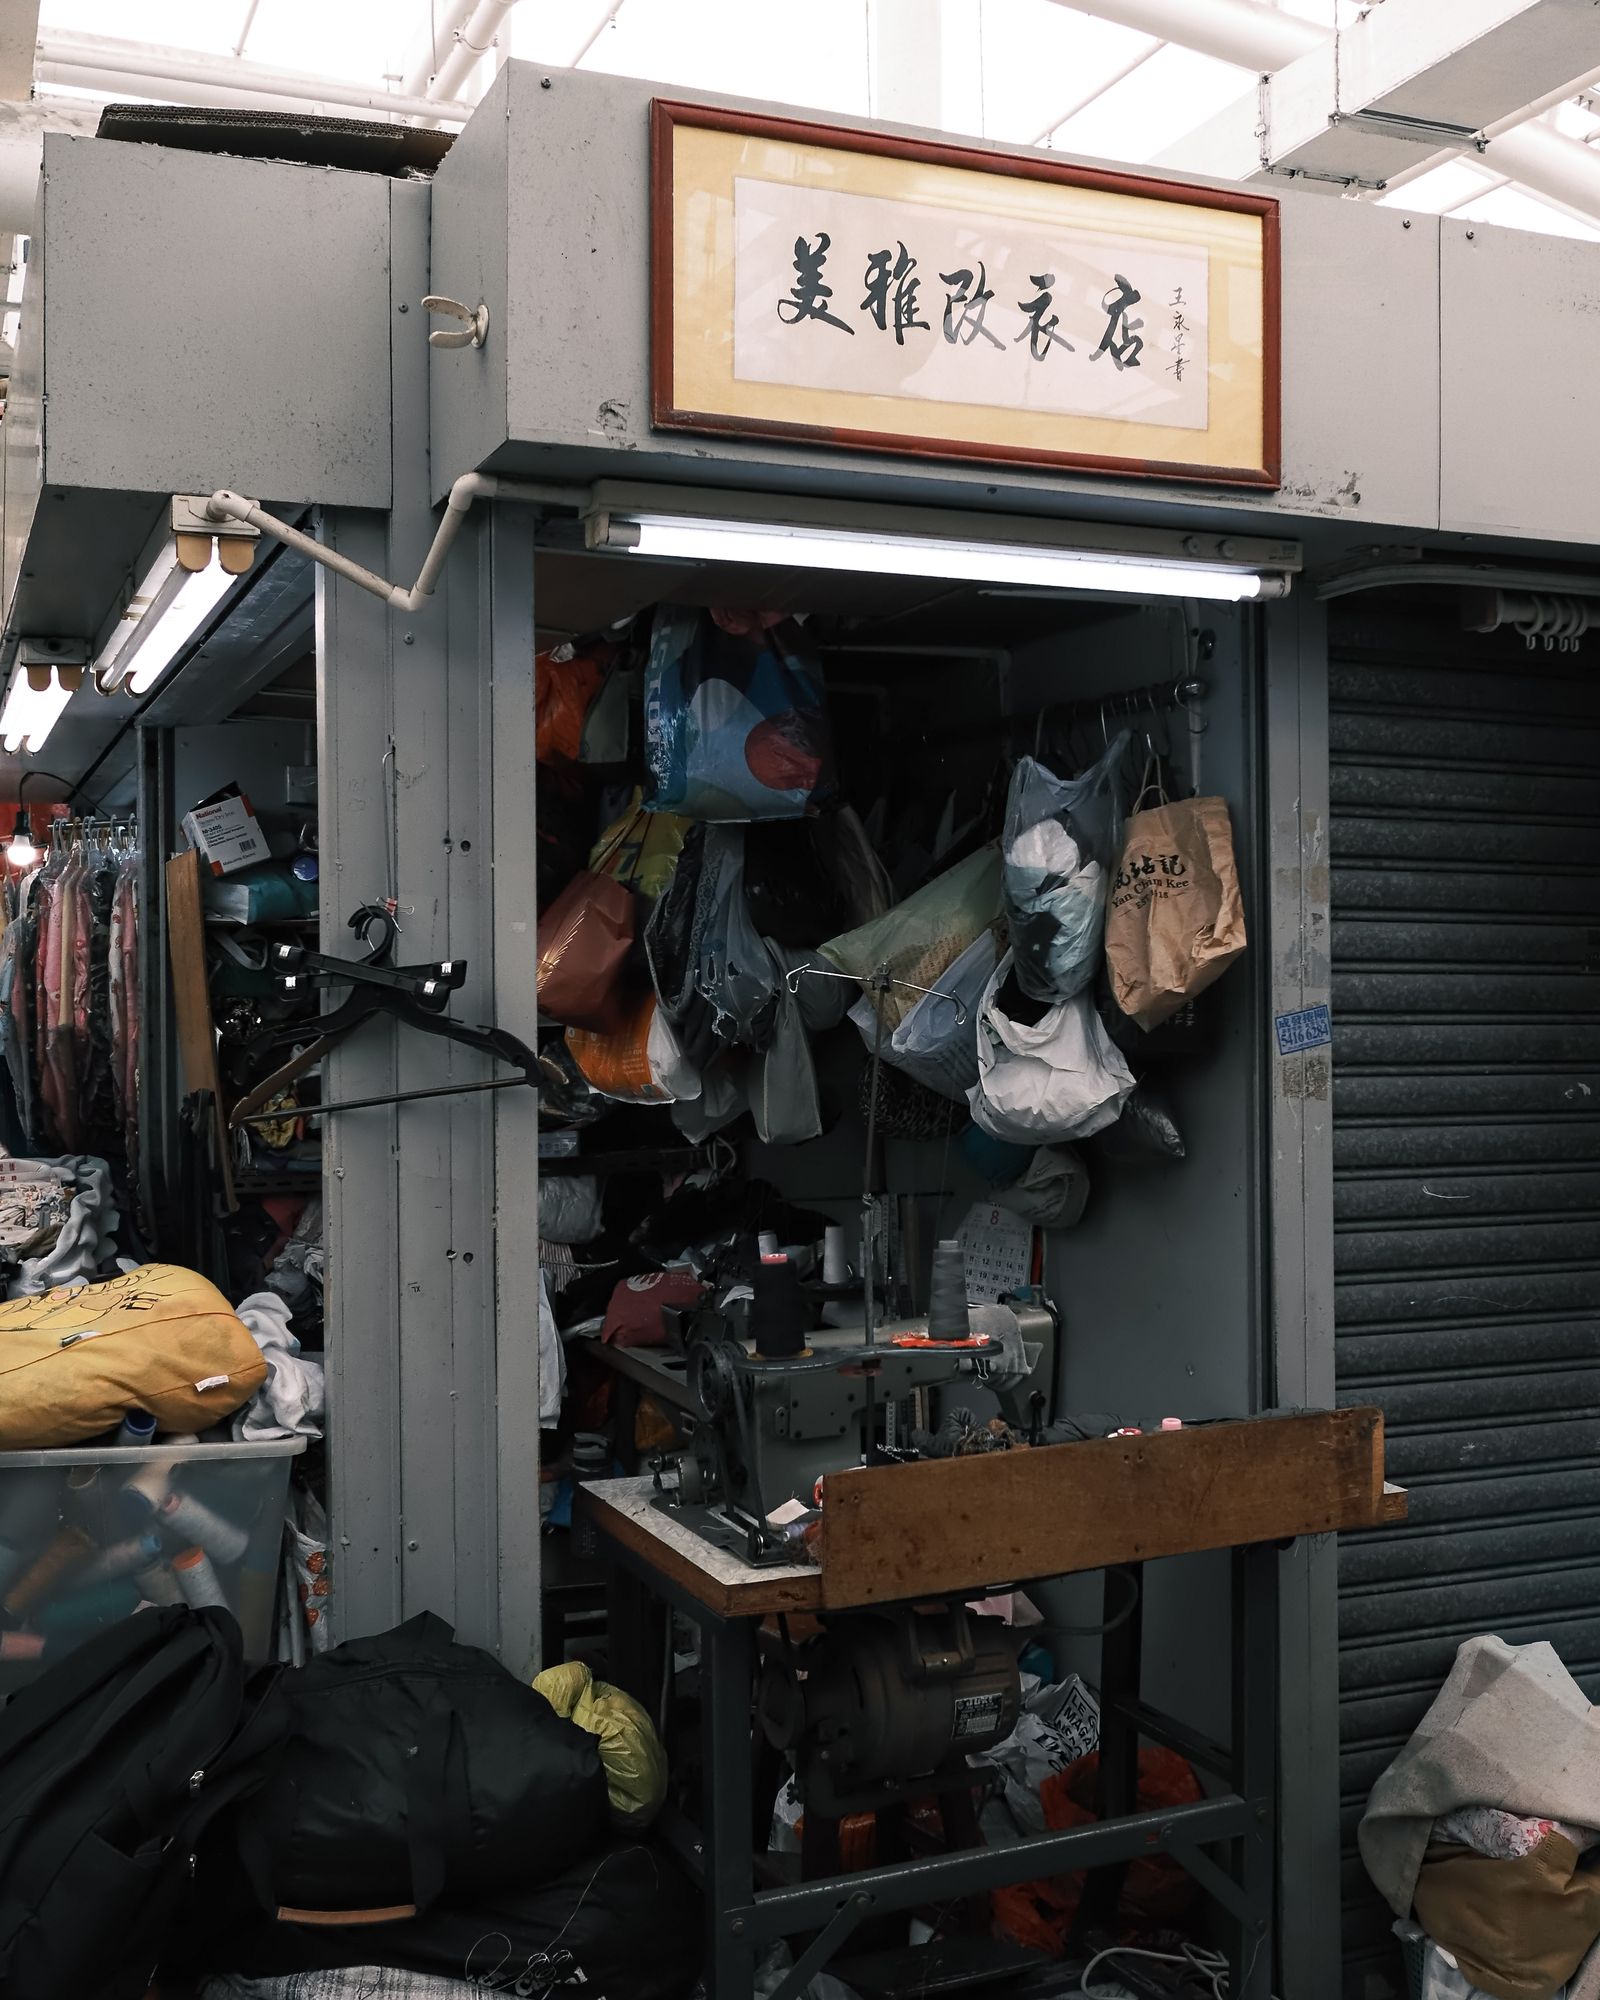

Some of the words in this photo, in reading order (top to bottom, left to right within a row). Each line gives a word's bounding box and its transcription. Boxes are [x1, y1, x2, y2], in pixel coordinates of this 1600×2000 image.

[778, 233, 1143, 371] 美雅改衣店
[195, 806, 222, 820] National
[1111, 893, 1133, 908] Yan
[1134, 877, 1162, 894] Chim
[1166, 878, 1189, 889] Kee
[1281, 1030, 1305, 1047] 5416
[1306, 1023, 1329, 1040] 6284
[990, 1210, 999, 1225] 8
[1072, 1694, 1086, 1717] LE
